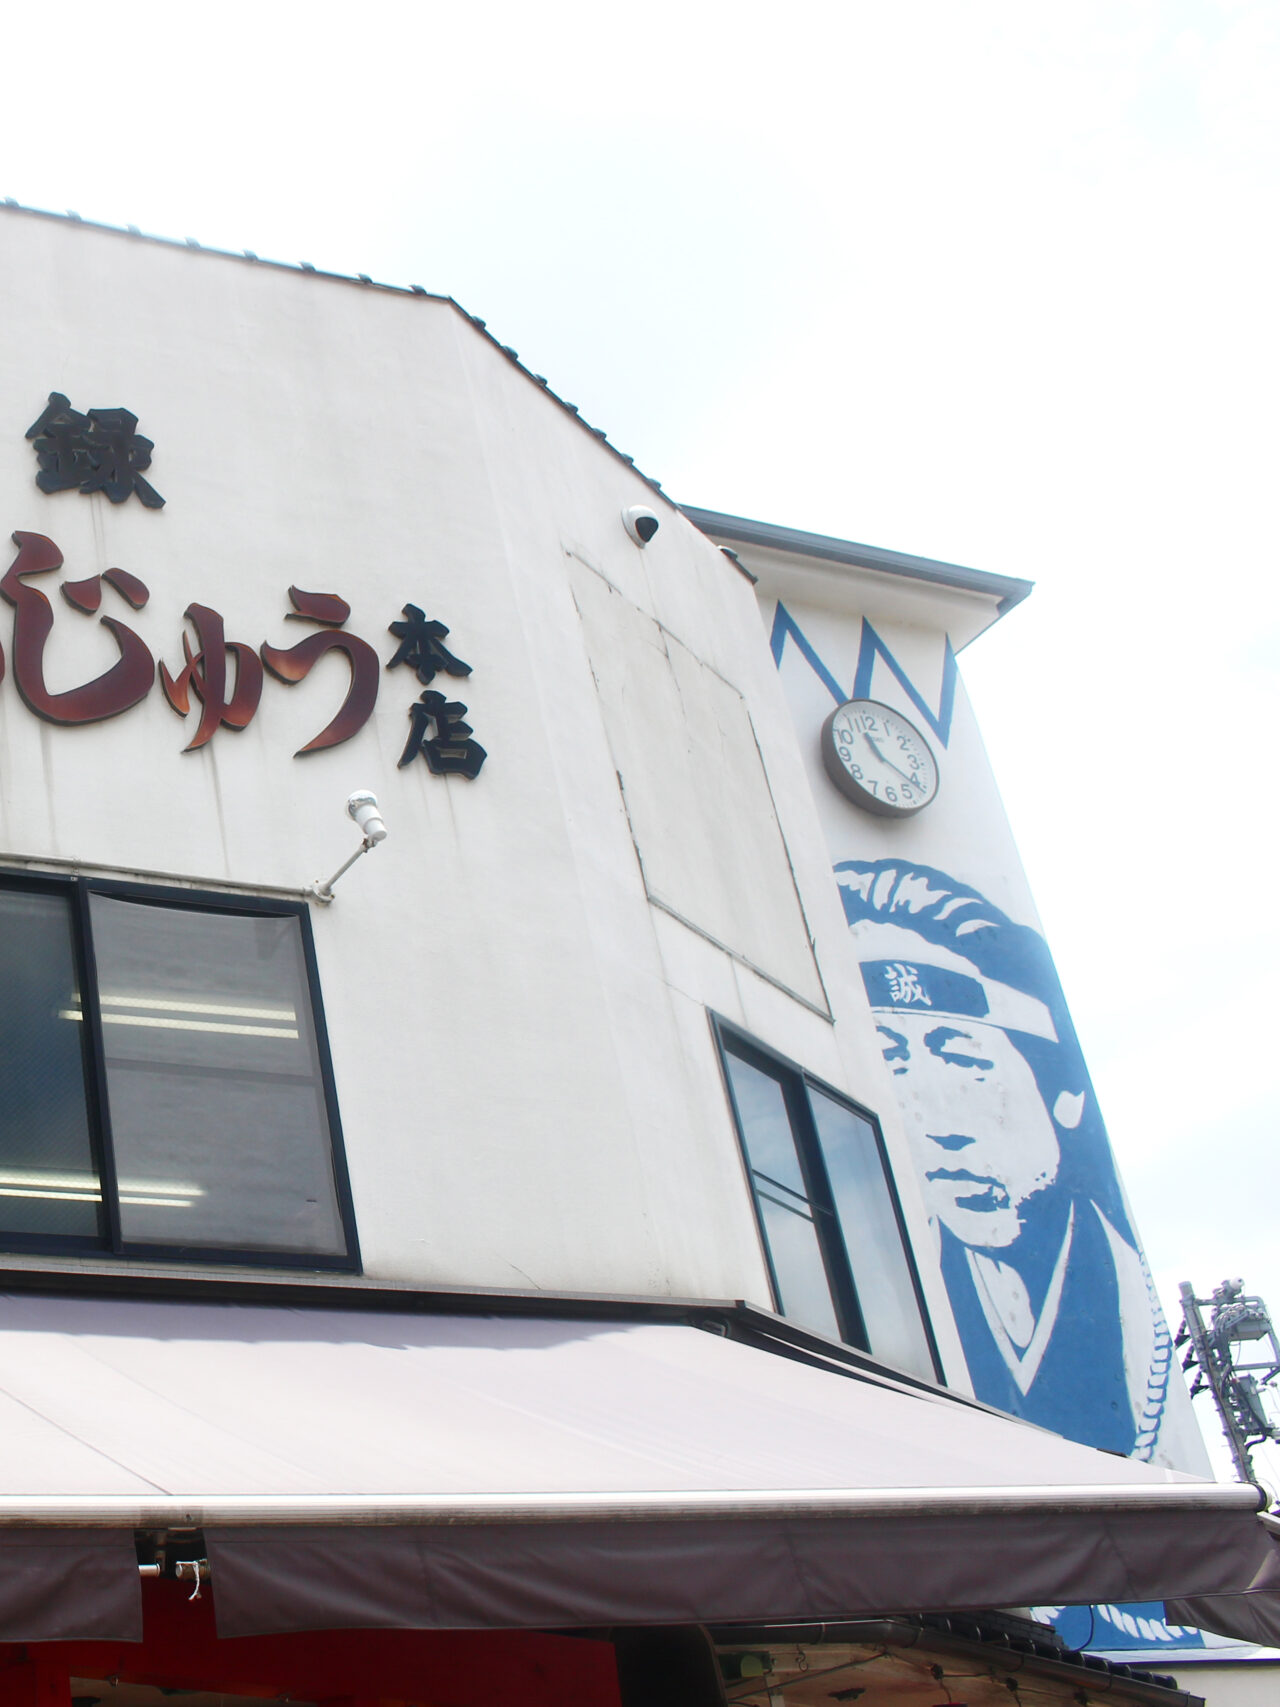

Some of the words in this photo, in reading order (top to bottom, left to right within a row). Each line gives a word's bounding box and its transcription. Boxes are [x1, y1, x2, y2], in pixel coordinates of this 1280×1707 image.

[386, 603, 487, 780] 本店
[848, 717, 861, 733] 11
[860, 714, 878, 731] 12
[883, 721, 890, 737] 1
[836, 728, 854, 745] 10
[896, 735, 910, 751] 2
[838, 746, 852, 762] 9
[907, 754, 920, 770] 3
[850, 763, 863, 780] 8
[910, 772, 922, 787] 4
[867, 780, 878, 796] 7
[885, 786, 898, 802] 6
[901, 783, 913, 799] 5
[884, 963, 932, 1006] 誠
